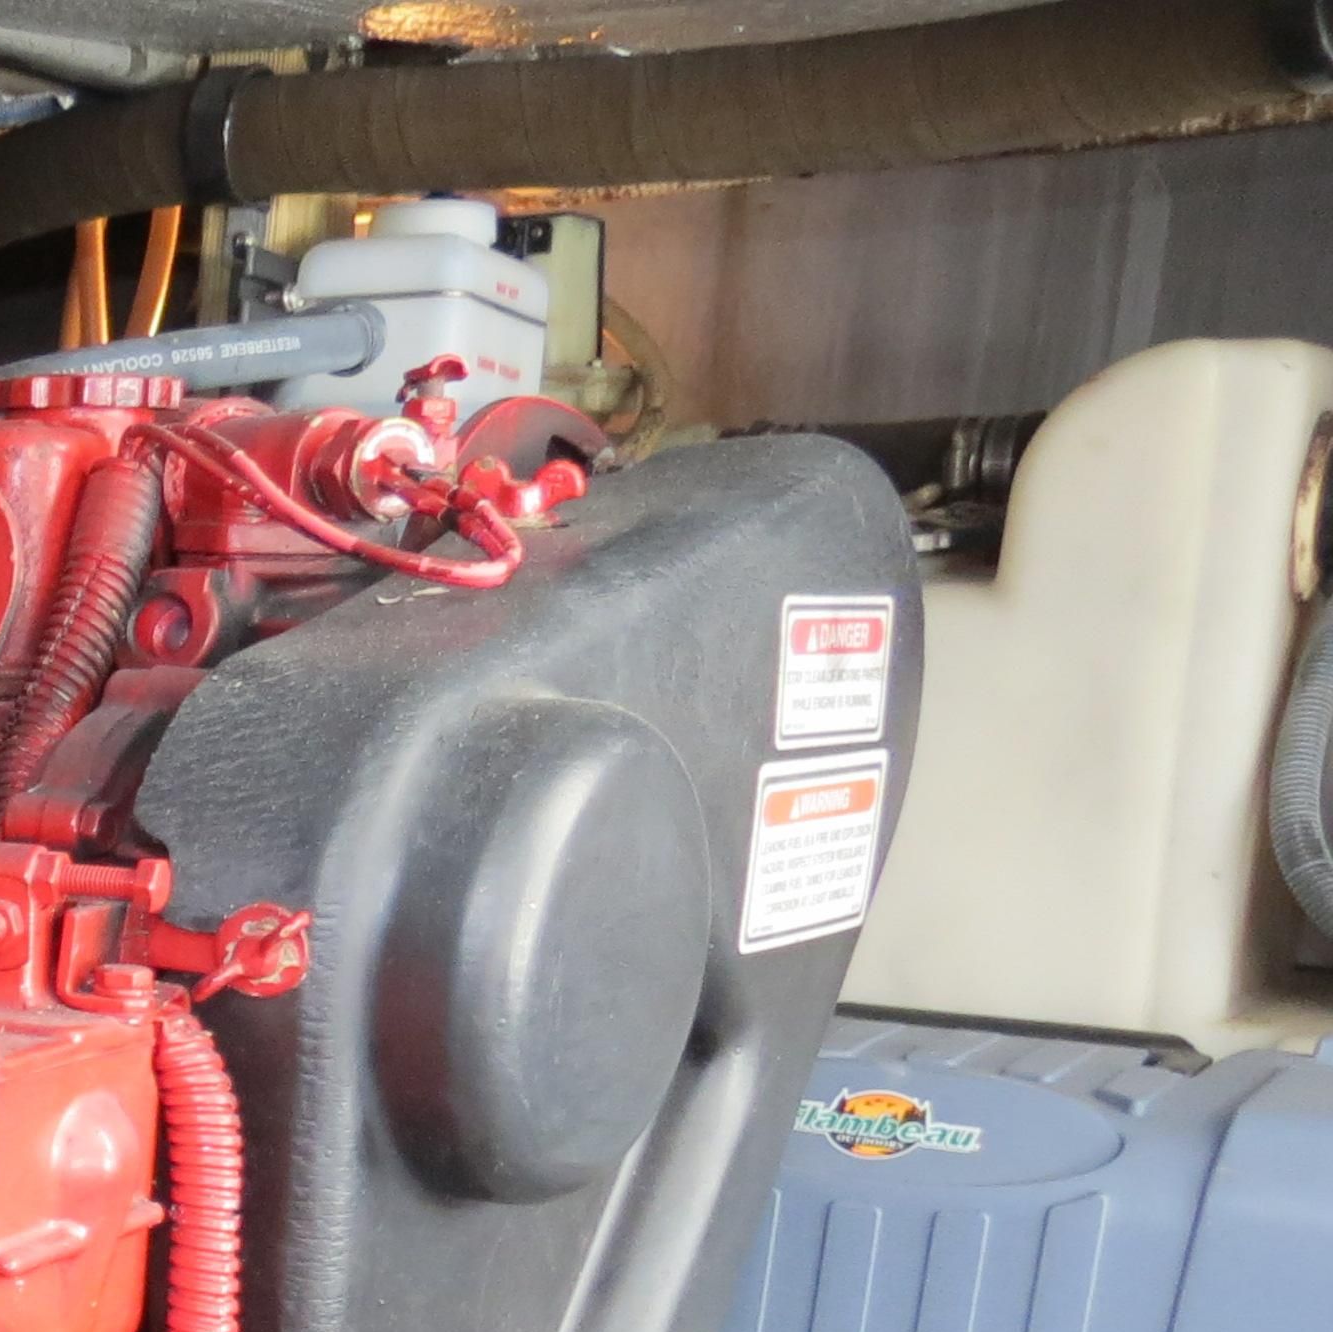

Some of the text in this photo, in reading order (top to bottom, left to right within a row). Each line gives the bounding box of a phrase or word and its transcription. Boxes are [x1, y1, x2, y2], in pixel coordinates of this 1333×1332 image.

[171, 346, 215, 365] 56526
[219, 336, 301, 358] WESTERBEKE
[819, 622, 870, 649] DANGER
[800, 786, 851, 816] WARNING
